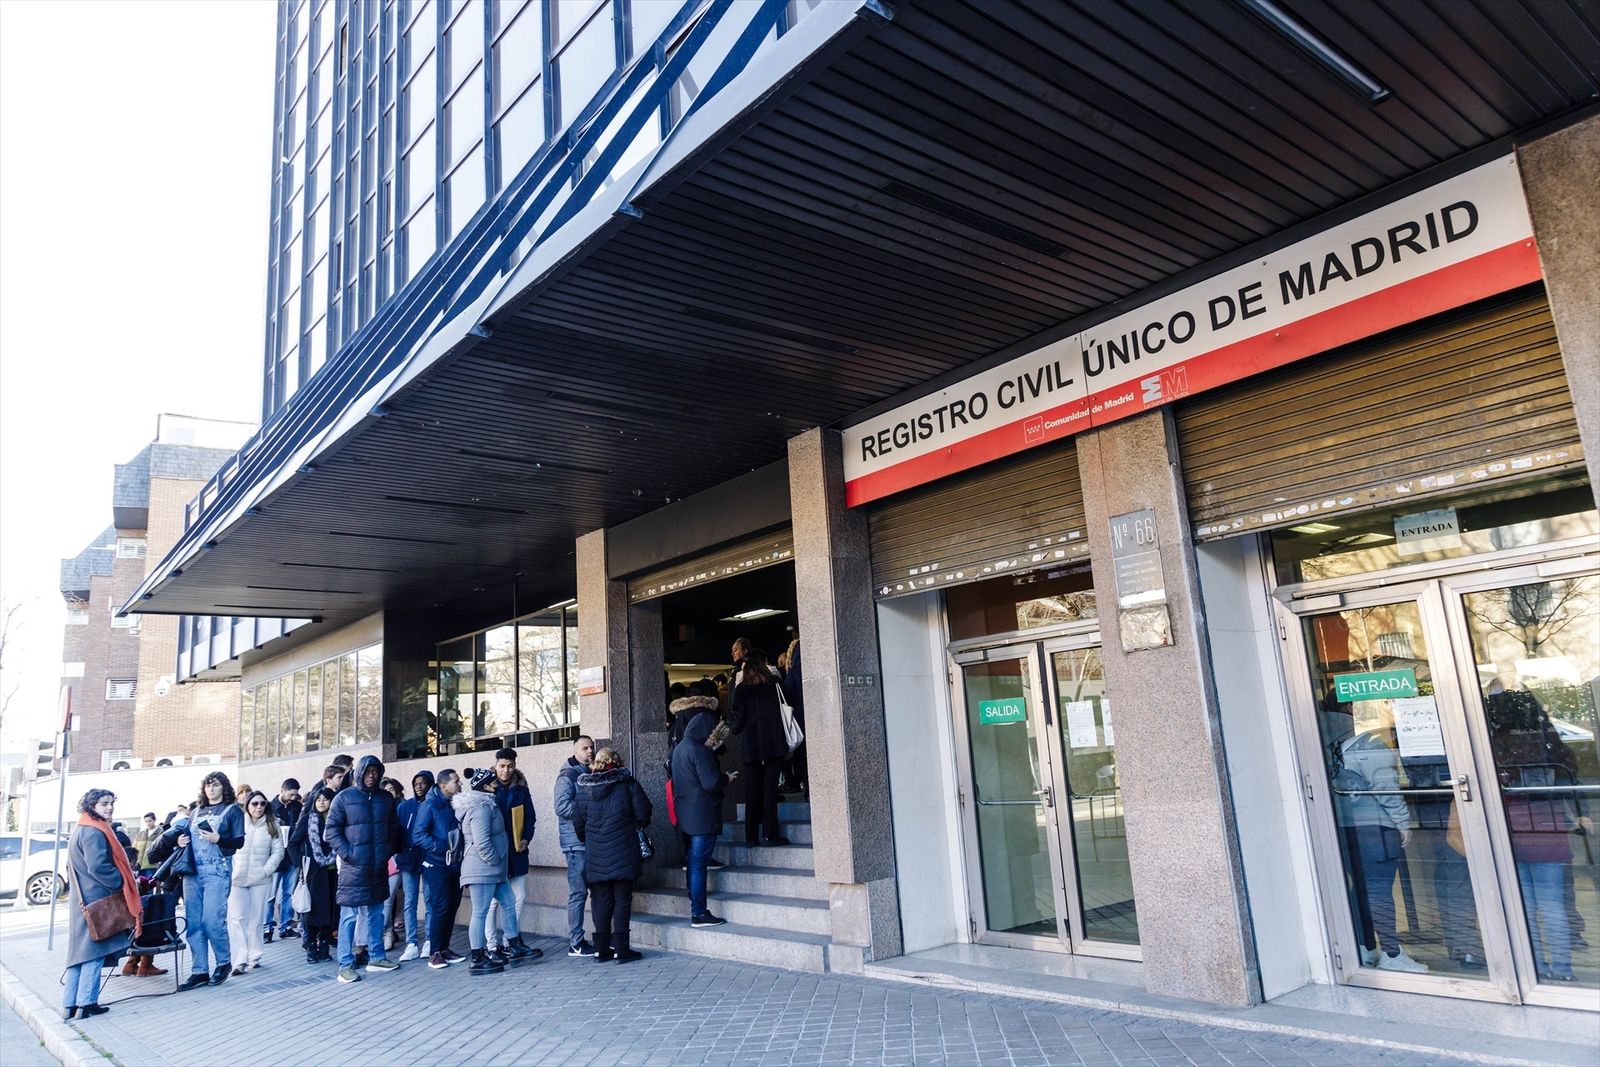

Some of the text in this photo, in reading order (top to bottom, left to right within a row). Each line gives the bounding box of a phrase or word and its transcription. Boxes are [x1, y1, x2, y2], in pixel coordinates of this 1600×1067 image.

[861, 200, 1480, 462] REGISTRO CIVIL ÚNICO DE MADRID
[1044, 393, 1135, 430] Comunidad de Madrid
[1113, 518, 1154, 549] Nº 66
[1401, 522, 1453, 537] ENTRADA
[1339, 677, 1412, 694] ENTRADA
[985, 705, 1020, 718] SALIDA
